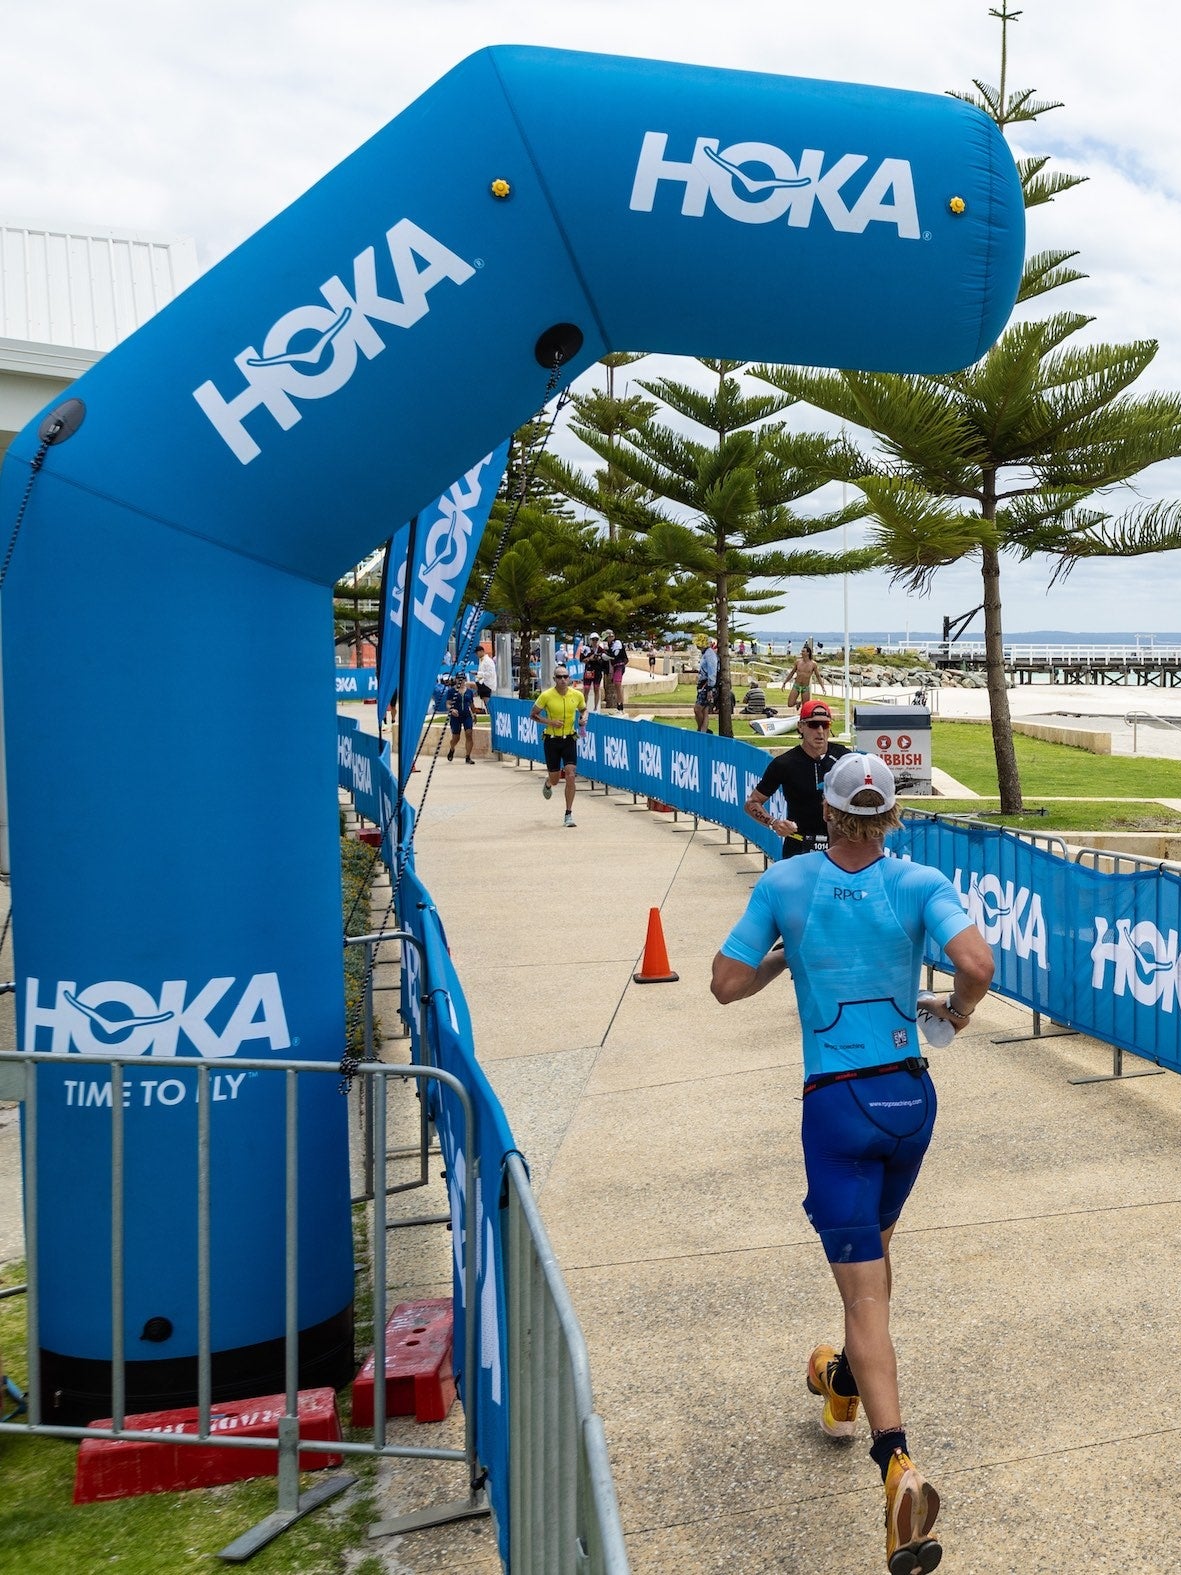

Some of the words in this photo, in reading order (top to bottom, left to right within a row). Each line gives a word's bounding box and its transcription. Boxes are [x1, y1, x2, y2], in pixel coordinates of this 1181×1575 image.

[629, 131, 921, 240] HOKA
[192, 217, 478, 466] HOKA
[336, 677, 357, 692] OKA
[496, 711, 512, 738] HOKA
[517, 715, 538, 745] HOKA
[603, 736, 629, 771] HOKA
[639, 741, 663, 780] HOKA
[671, 750, 699, 792] HOKA
[877, 753, 922, 766] BBISH
[352, 752, 372, 796] HOKA
[711, 759, 738, 806] HOKA
[814, 842, 829, 850] 1014
[833, 887, 863, 900] RPG
[953, 868, 1048, 970] HOKA
[24, 972, 291, 1058] HOKA
[140, 1079, 186, 1106] TO
